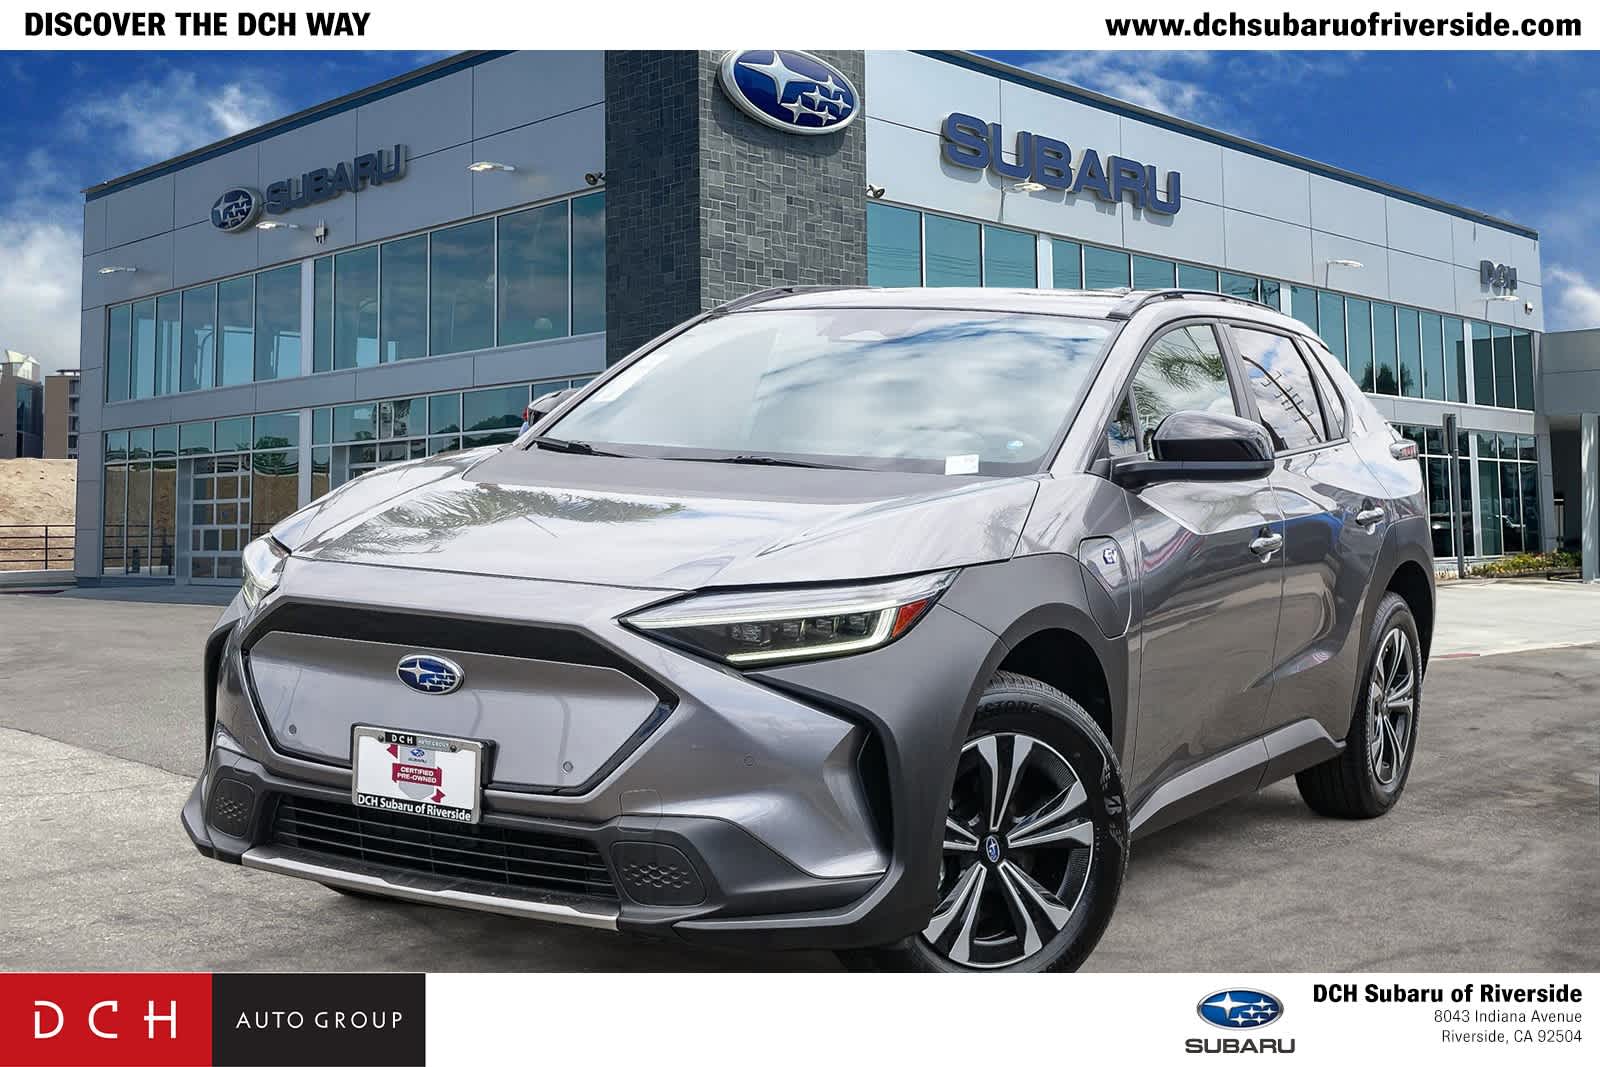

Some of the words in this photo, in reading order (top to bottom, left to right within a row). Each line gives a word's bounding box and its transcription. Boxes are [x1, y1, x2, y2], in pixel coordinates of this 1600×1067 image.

[941, 112, 1181, 215] SUBARU
[266, 144, 407, 214] SUBARU
[391, 734, 413, 745] DCH
[397, 773, 437, 784] PRE-OWNED
[400, 766, 434, 777] CERTIFIED
[358, 795, 378, 807] DCH
[380, 798, 414, 812] Subaru
[415, 803, 426, 814] of
[427, 805, 471, 821] Riverside
